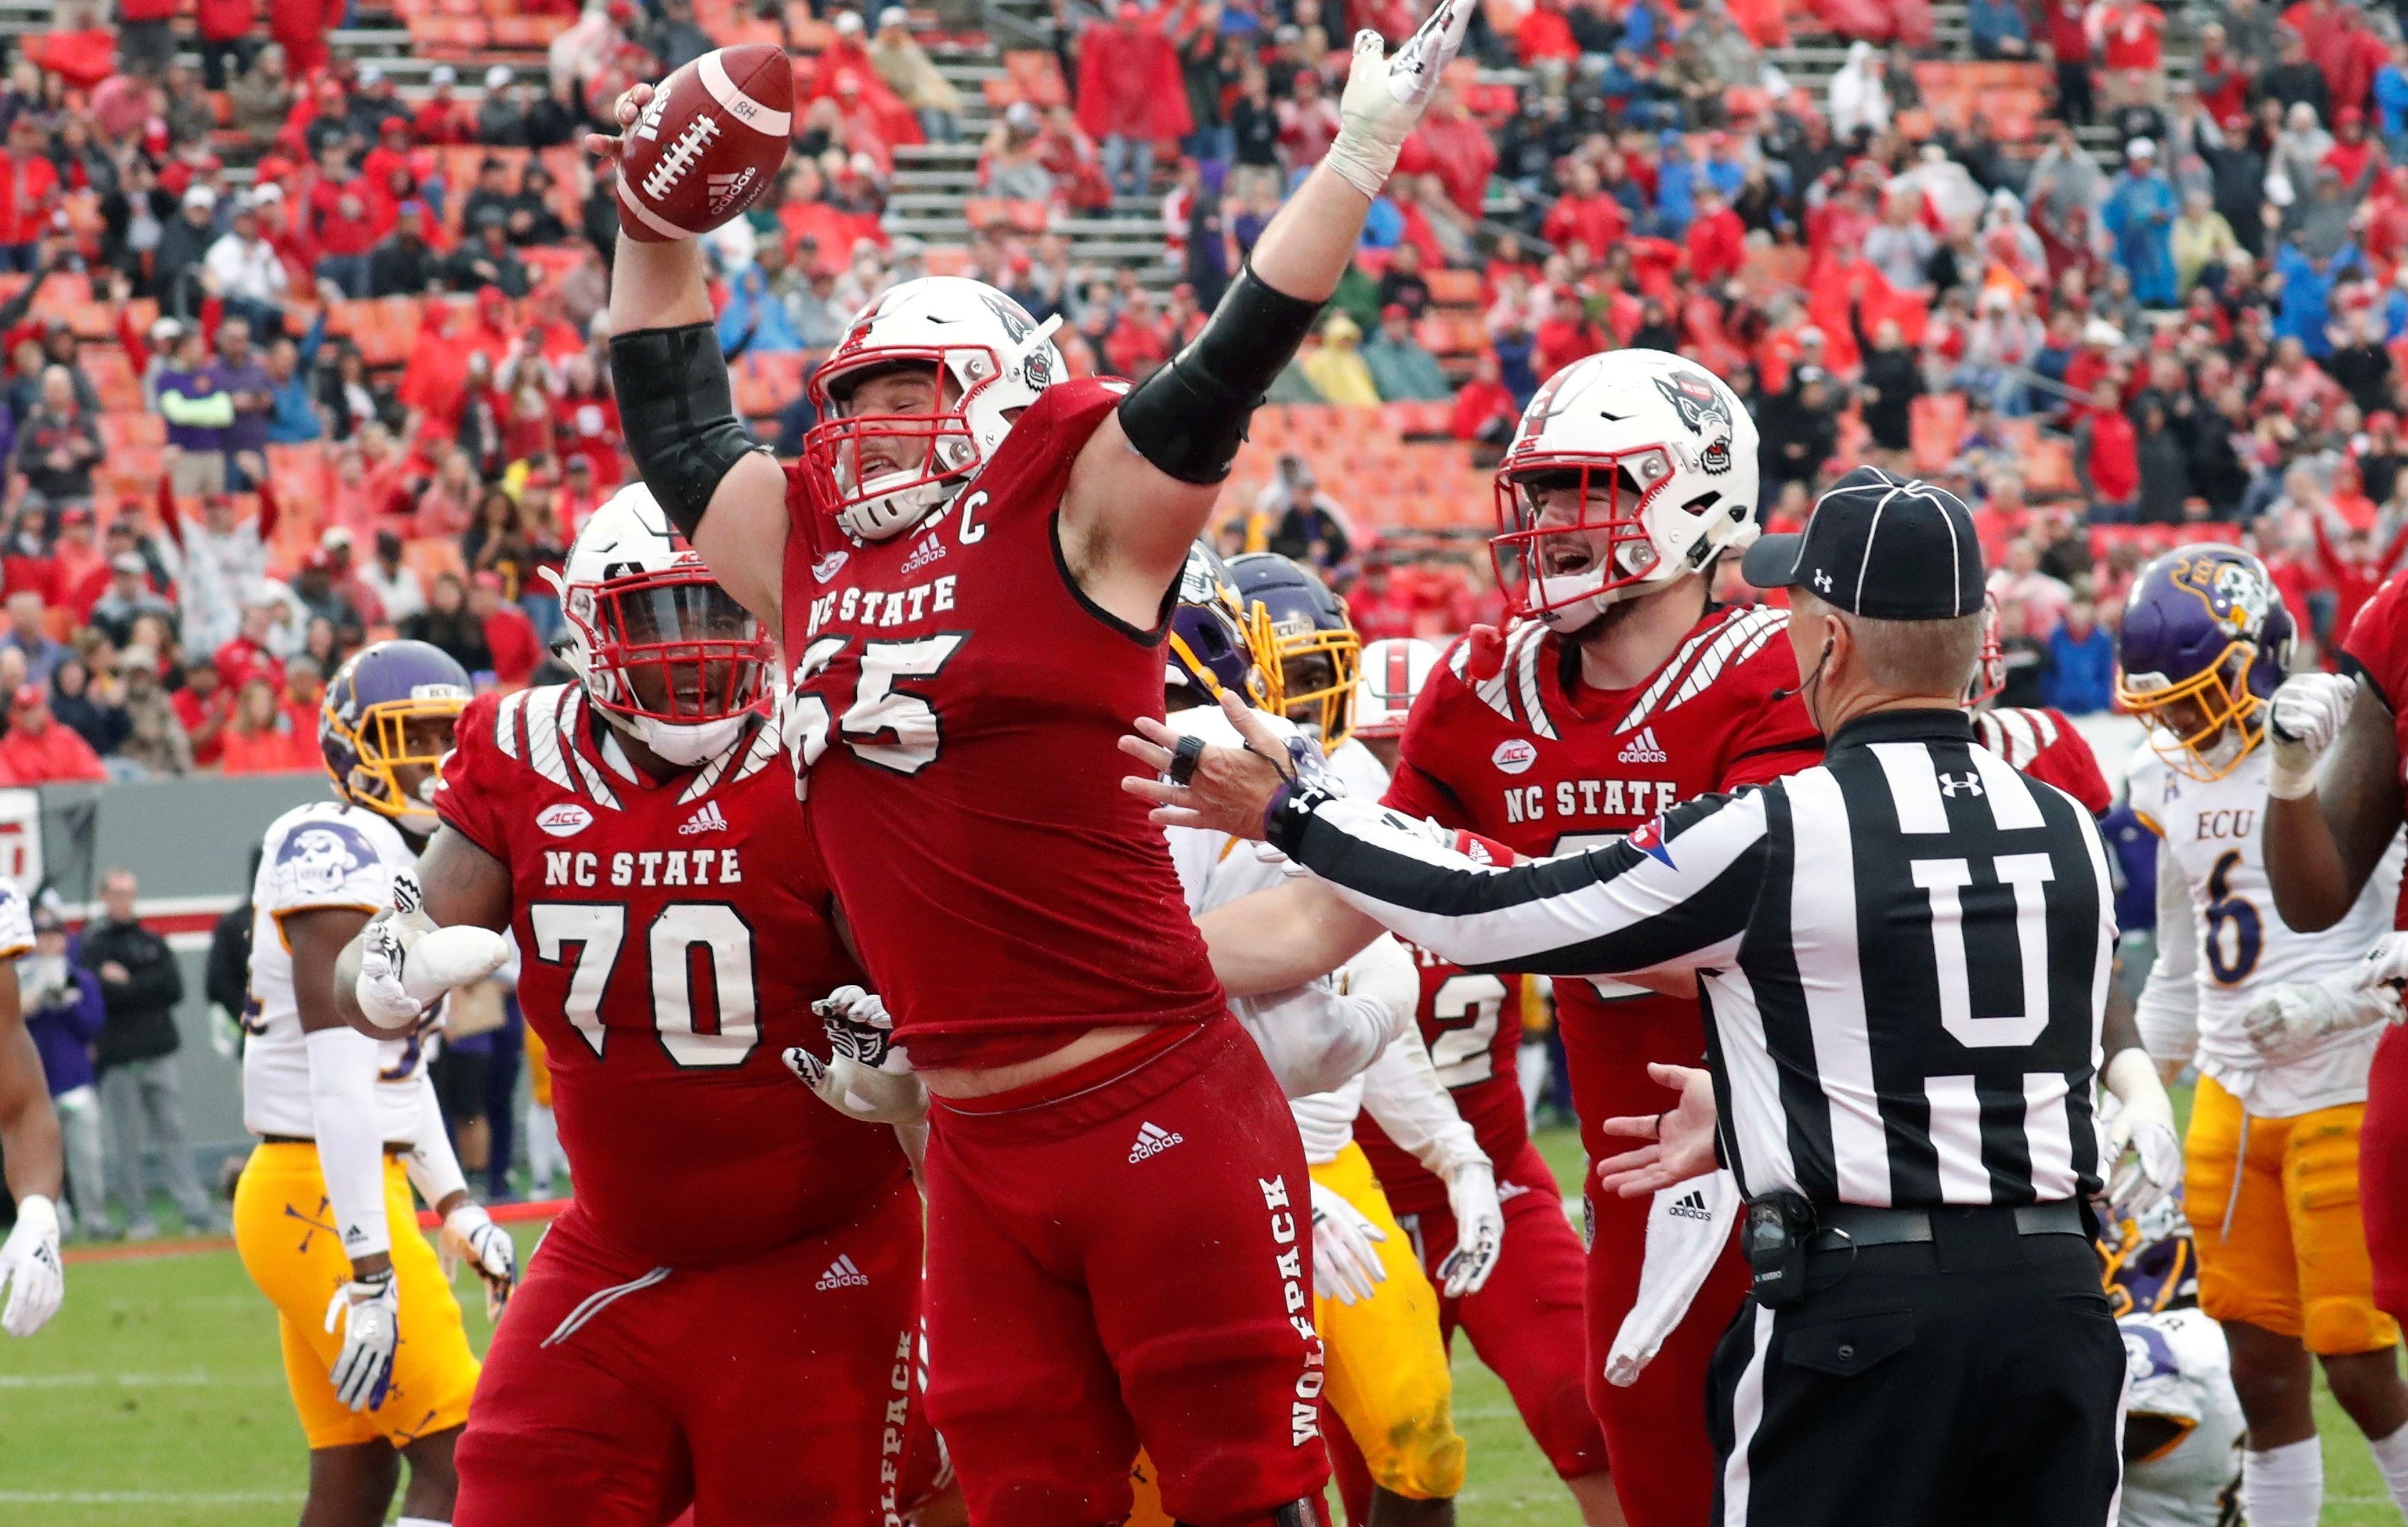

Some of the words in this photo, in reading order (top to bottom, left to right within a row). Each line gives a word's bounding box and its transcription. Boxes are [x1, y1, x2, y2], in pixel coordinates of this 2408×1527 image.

[733, 101, 758, 120] BH
[711, 167, 756, 214] adidas
[958, 489, 989, 545] C
[901, 545, 946, 574] adidas
[806, 590, 837, 638] NC
[839, 574, 957, 628] STATE
[780, 632, 970, 800] 65
[1501, 746, 1530, 761] ACC
[1617, 749, 1667, 764] adidas
[545, 812, 584, 824] ACC
[1503, 785, 1545, 823] NC
[1556, 780, 1677, 816] STATE
[678, 818, 727, 835] adidas
[2197, 810, 2254, 841] ECU
[544, 850, 597, 887] NC
[611, 847, 742, 887] STATE
[2205, 848, 2263, 989] 6
[1910, 852, 2056, 1049] U
[530, 901, 761, 1068] 70
[1128, 1130, 1183, 1164] adidas
[1669, 1206, 1712, 1221] adidas
[815, 1272, 868, 1291] adidas
[1259, 1174, 1325, 1447] WOLFPACK
